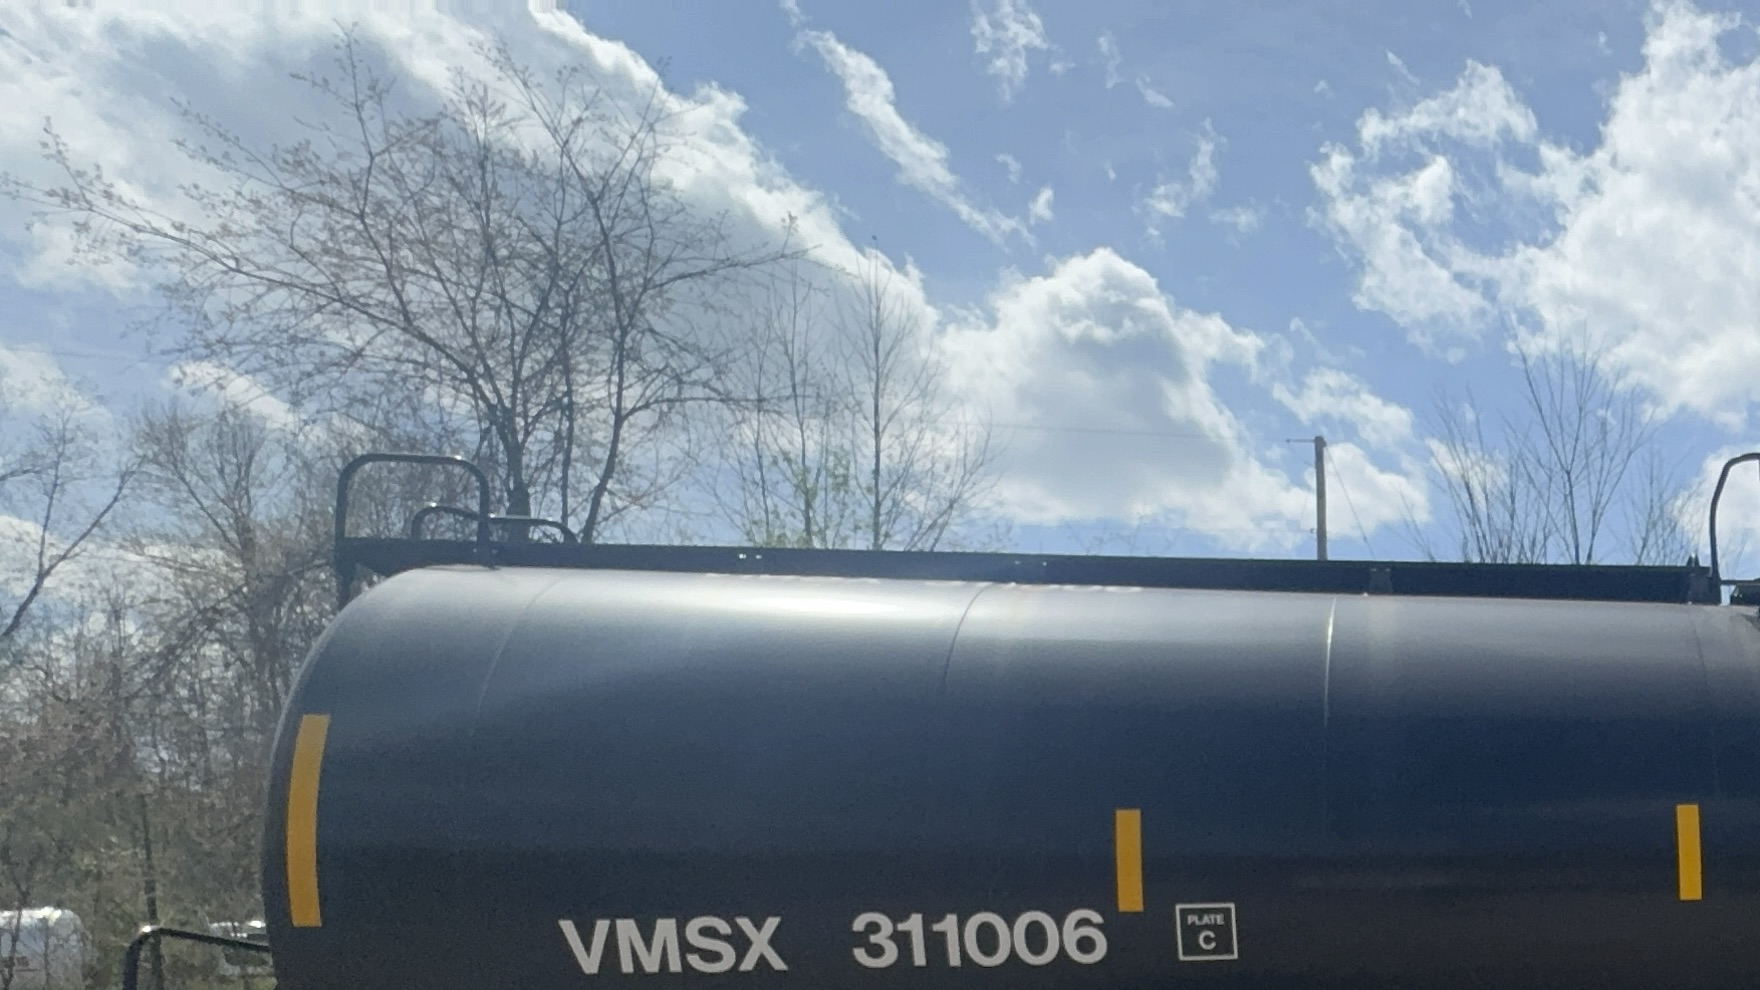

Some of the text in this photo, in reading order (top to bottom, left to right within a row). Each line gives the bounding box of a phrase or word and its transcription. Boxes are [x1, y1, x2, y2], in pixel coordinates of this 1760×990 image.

[1187, 913, 1225, 926] PLATE
[558, 908, 1108, 975] VMSX 311006
[1199, 929, 1217, 951] C
